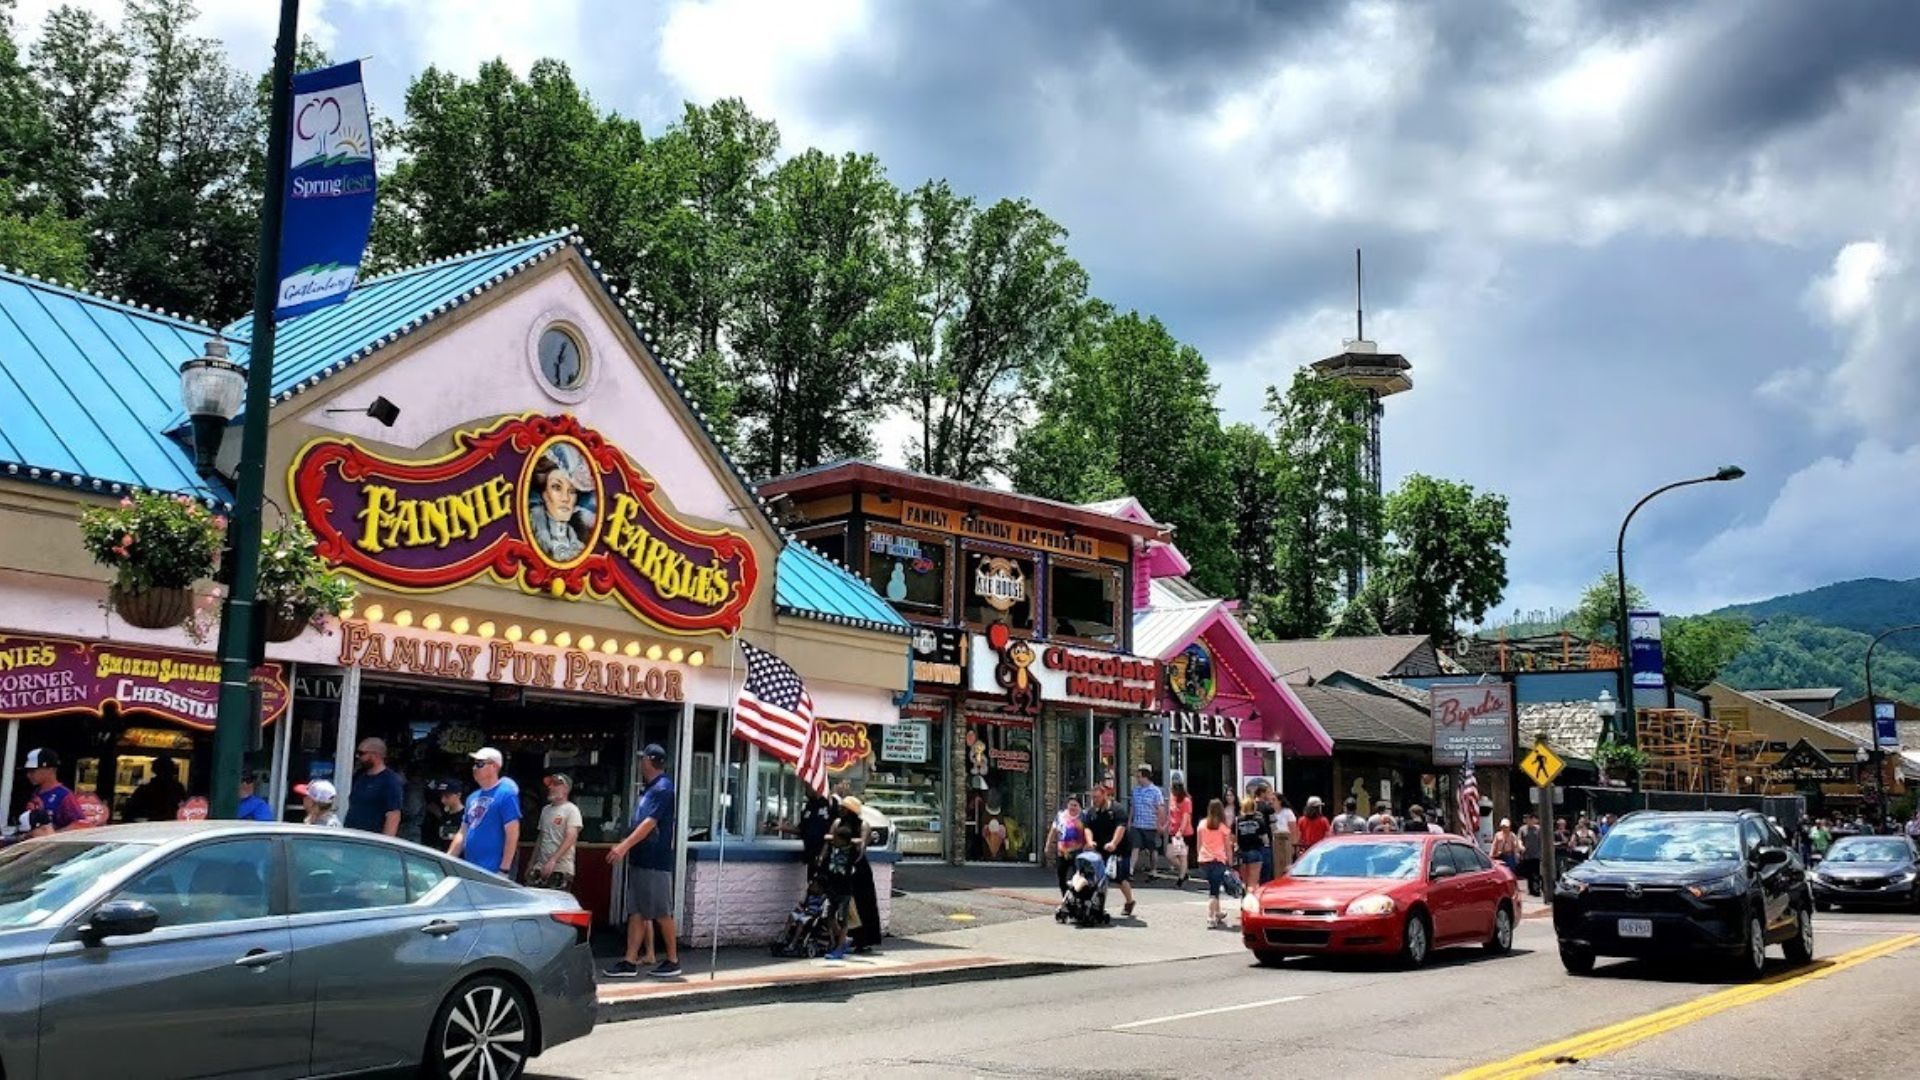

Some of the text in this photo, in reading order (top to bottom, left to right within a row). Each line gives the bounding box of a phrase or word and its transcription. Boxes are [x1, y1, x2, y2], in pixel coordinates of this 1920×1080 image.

[292, 174, 369, 198] Springfest
[357, 474, 729, 606] FANNIE FARKLE'S
[96, 653, 159, 678] SMOKED
[158, 658, 222, 683] SAUSAGE
[339, 621, 685, 702] FAMILY FUN PARLOR
[1042, 646, 1159, 681] Chocolate
[0, 670, 75, 692] ORNER
[1066, 675, 1154, 709] Monkey
[116, 679, 219, 719] CHEESESTEA
[1438, 690, 1504, 732] Byrd's
[820, 730, 856, 749] DOGS
